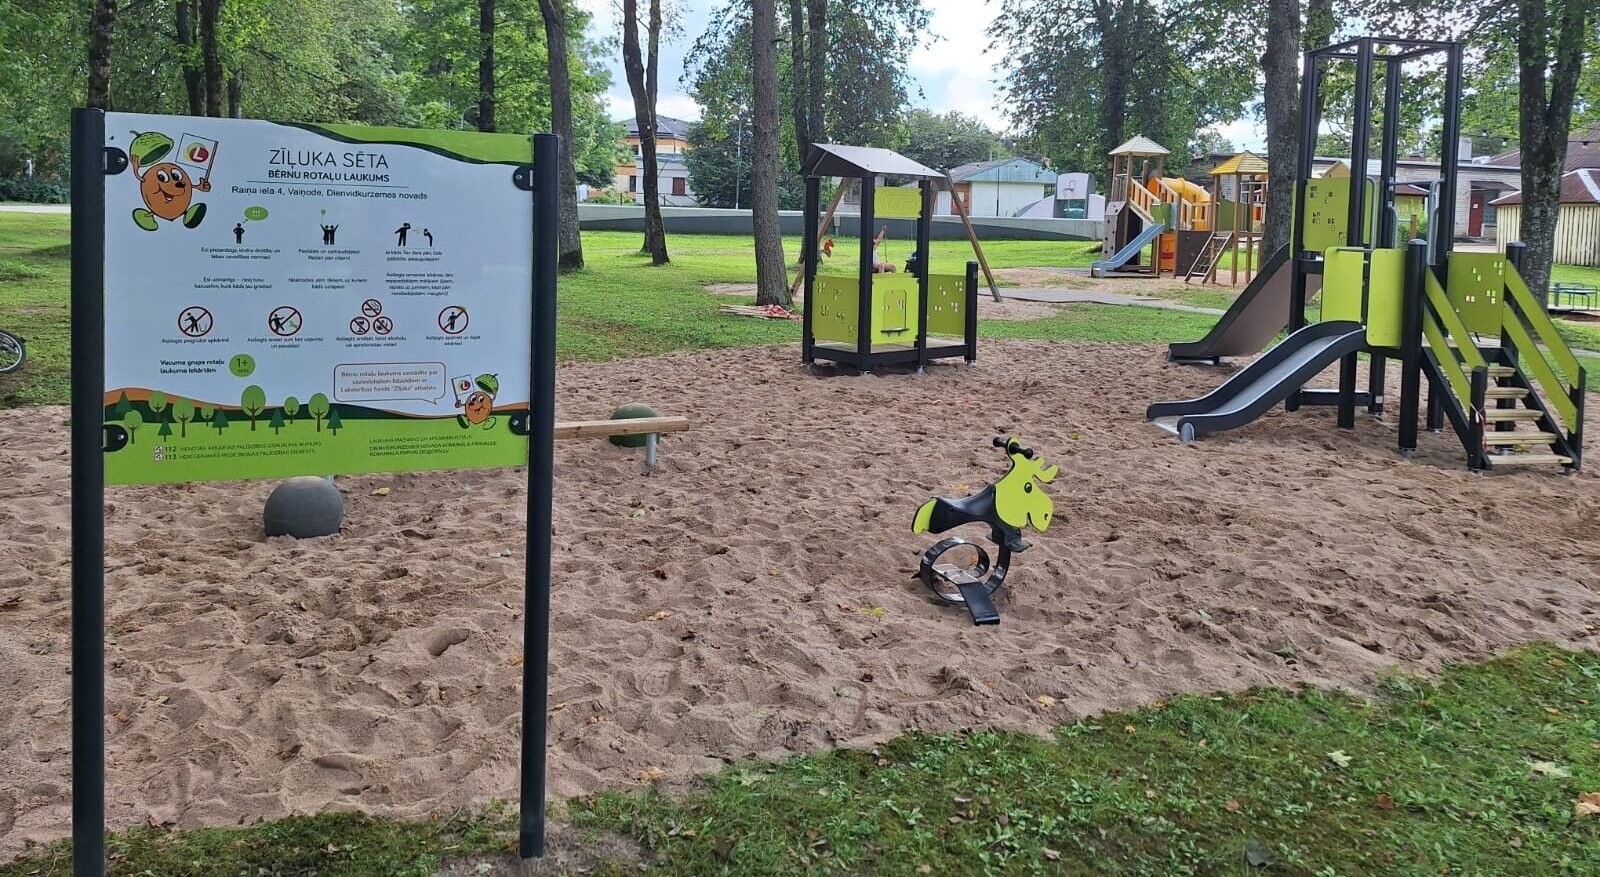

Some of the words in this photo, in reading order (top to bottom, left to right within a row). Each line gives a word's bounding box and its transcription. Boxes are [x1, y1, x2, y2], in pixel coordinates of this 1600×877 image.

[269, 147, 337, 169] ZĪĻUKA
[342, 151, 389, 169] SĒTA
[268, 169, 301, 180] BĒRNU
[303, 171, 342, 183] ROTAĻU
[343, 173, 390, 183] LAUKUMS
[231, 185, 257, 196] Raiņa
[259, 186, 275, 195] iela
[277, 187, 285, 196] 4,
[287, 187, 324, 198] Vaiņode,
[326, 188, 397, 199] Dienvidkurzemes
[398, 191, 428, 200] novads
[236, 357, 248, 368] 1+
